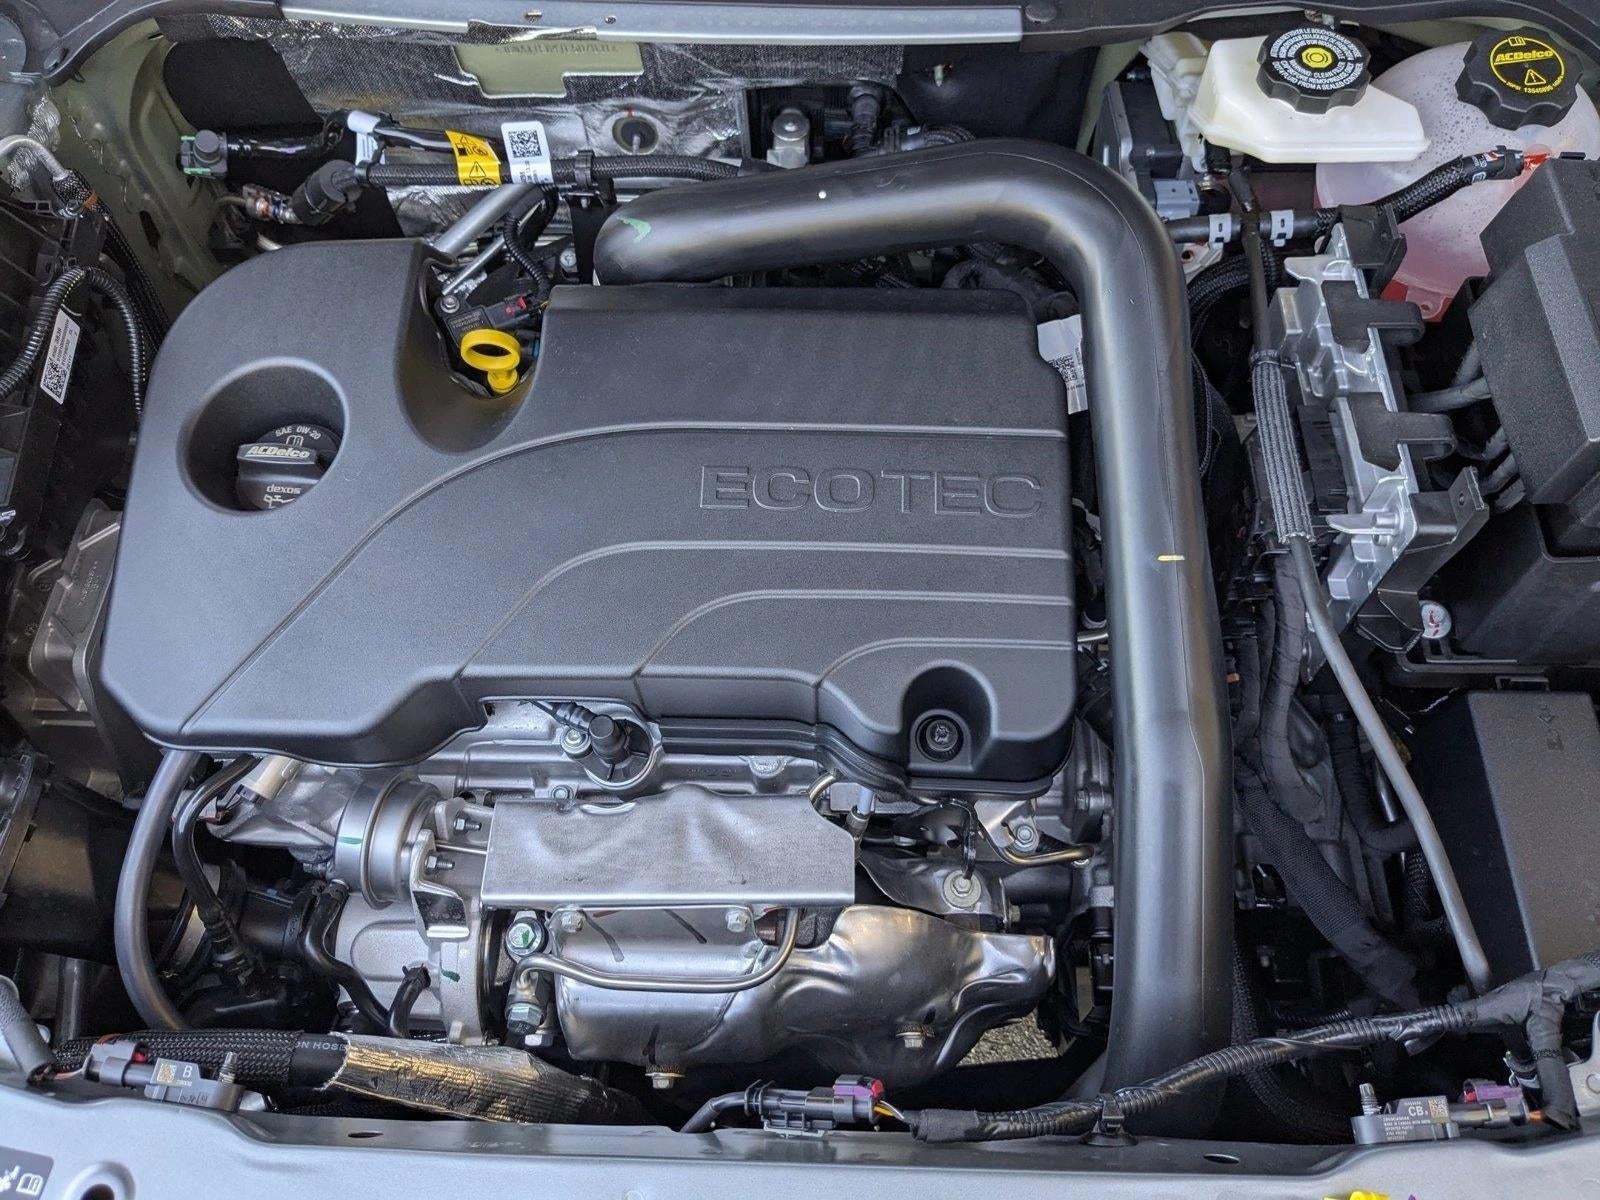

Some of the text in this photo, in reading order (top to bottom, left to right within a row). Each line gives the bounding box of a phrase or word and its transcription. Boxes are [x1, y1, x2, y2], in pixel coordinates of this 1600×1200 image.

[1494, 50, 1554, 63] ACDelco
[1279, 71, 1298, 84] FLUID
[1295, 80, 1315, 89] FROM
[275, 425, 322, 440] SAE 0W-20
[246, 446, 310, 458] ACDelco
[266, 484, 302, 494] dexos
[700, 464, 1042, 518] ECOTEC
[182, 1066, 192, 1078] B
[1408, 1106, 1424, 1116] CB
